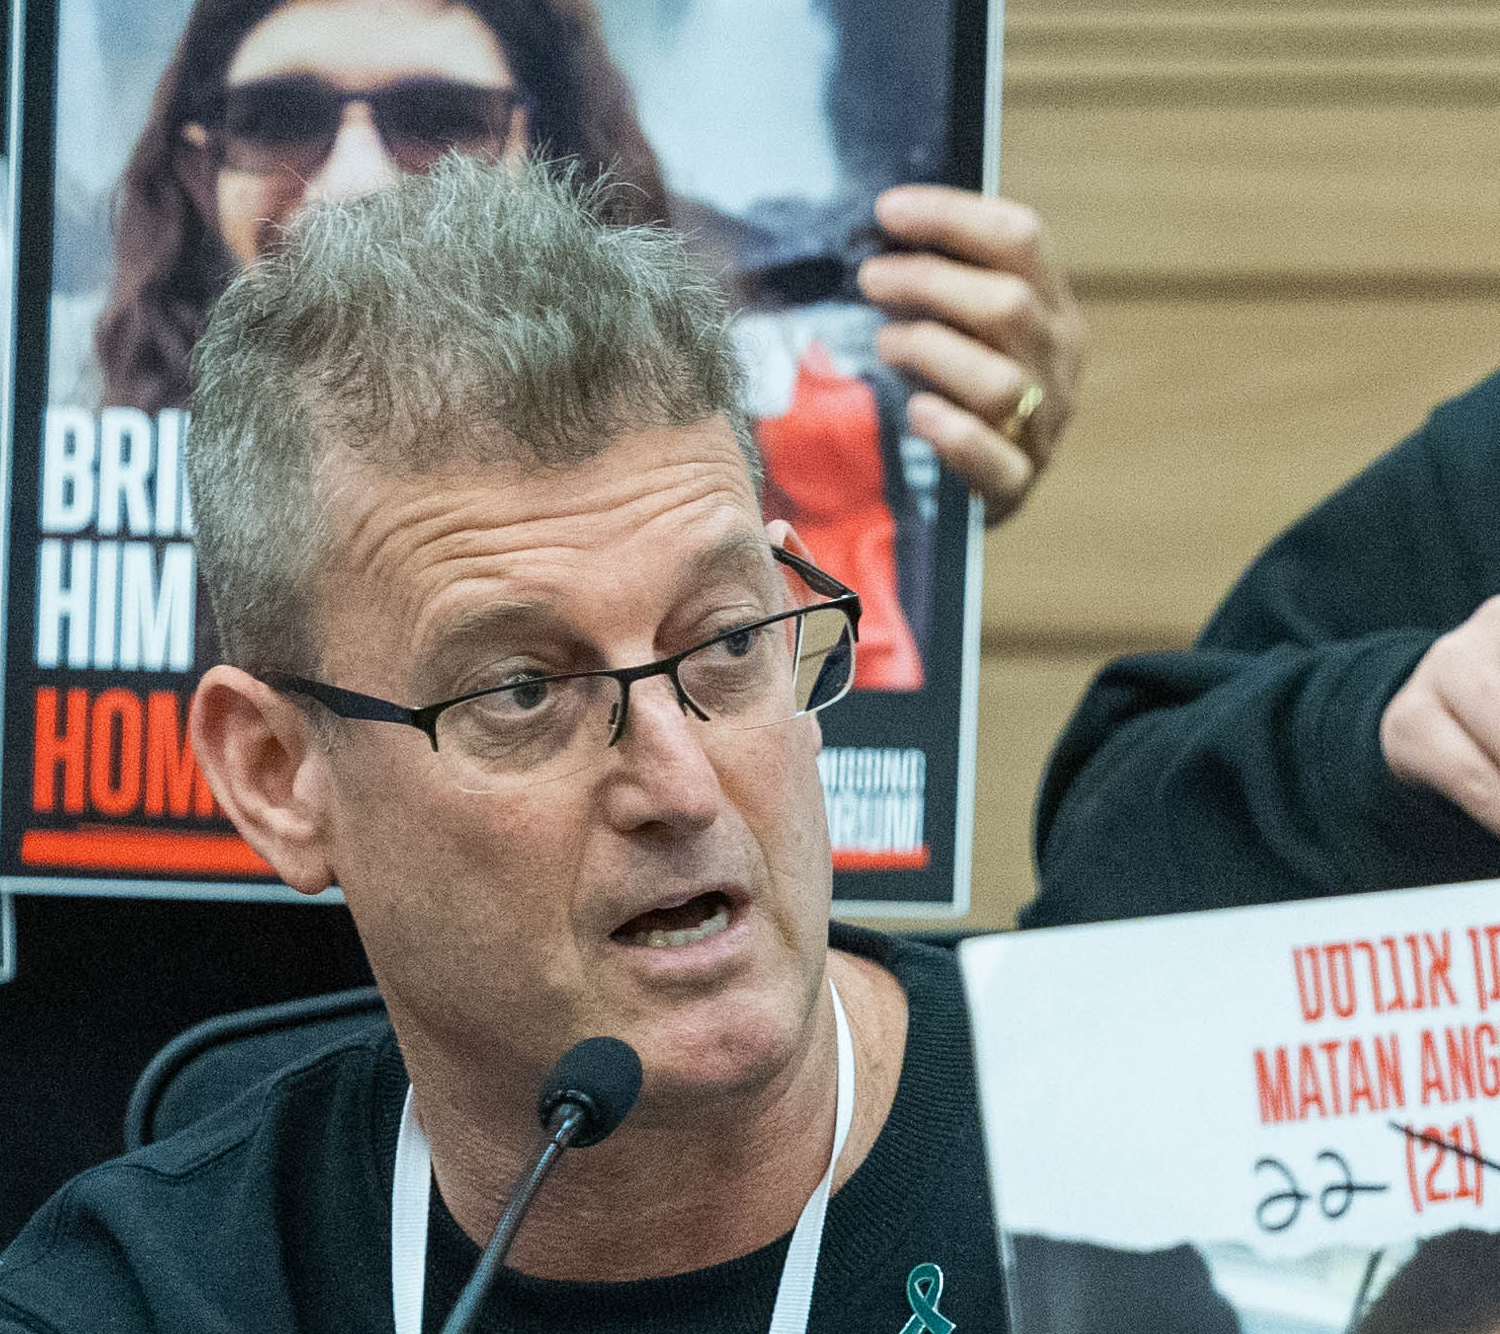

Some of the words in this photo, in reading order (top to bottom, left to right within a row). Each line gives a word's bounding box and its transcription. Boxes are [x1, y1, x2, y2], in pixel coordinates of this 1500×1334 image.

[41, 405, 196, 538] BRI
[35, 537, 196, 673] HIM
[31, 685, 228, 819] HOM
[1292, 930, 1459, 1024] אנגרסט
[1253, 1031, 1405, 1125] MATAN
